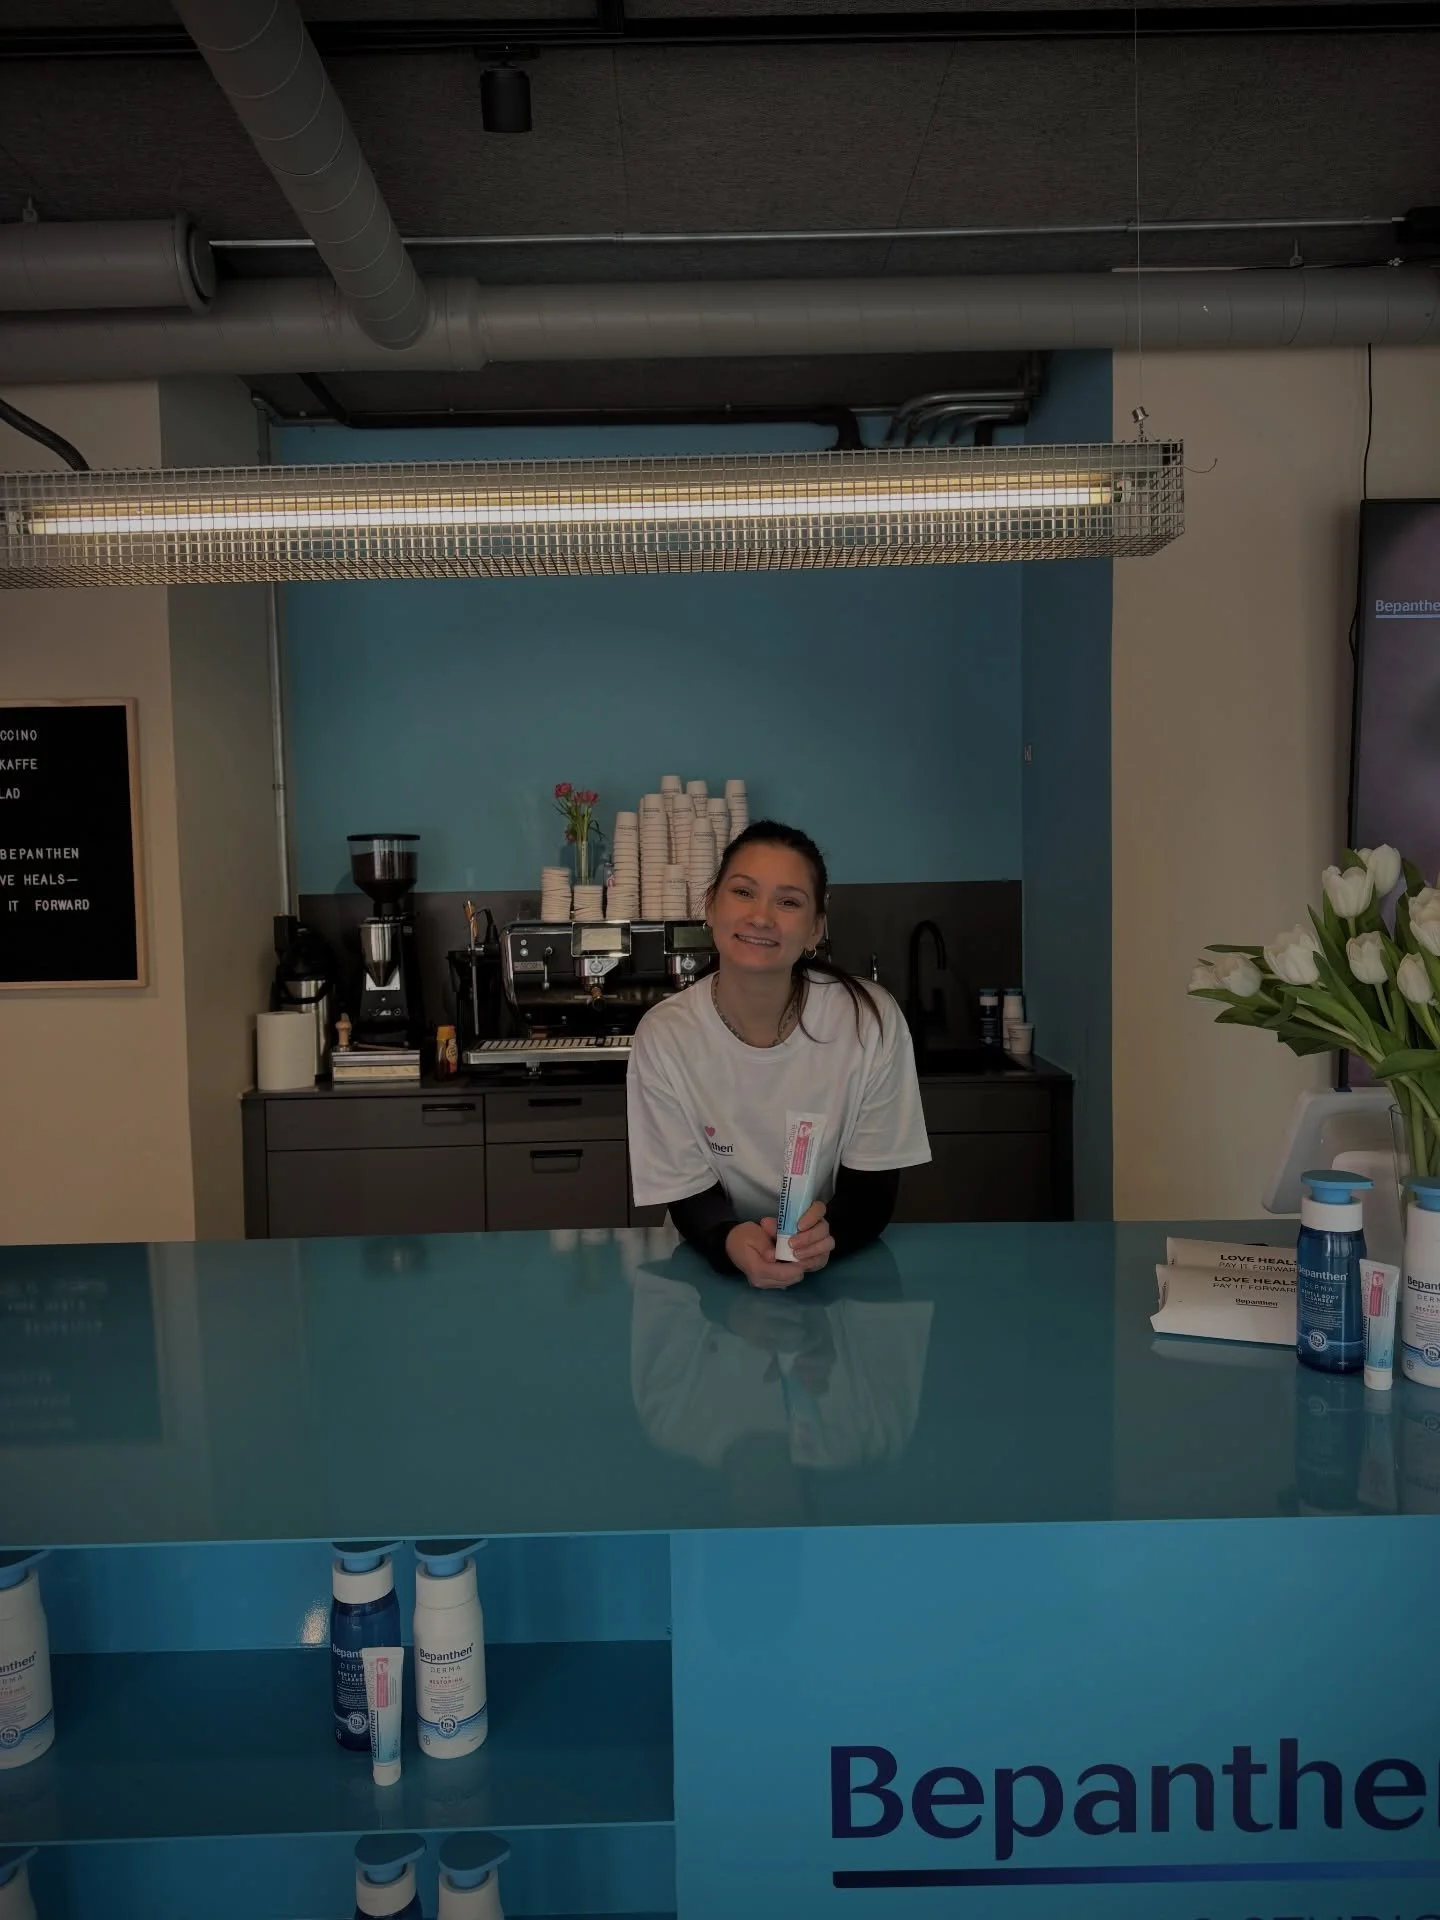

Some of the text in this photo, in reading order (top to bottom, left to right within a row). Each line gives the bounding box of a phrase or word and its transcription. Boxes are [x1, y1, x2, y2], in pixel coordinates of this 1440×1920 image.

[0, 729, 38, 742] CCINO
[0, 758, 38, 771] KAFFE
[0, 847, 80, 861] BEPANTHEN
[8, 898, 90, 912] IT FORWARD
[1219, 1261, 1236, 1269] PAY
[1220, 1254, 1297, 1266] LOVE HEAL
[1214, 1276, 1250, 1284] LOVE
[420, 1644, 473, 1663] Bepanthen
[830, 1737, 1440, 1861] Bepanthe
